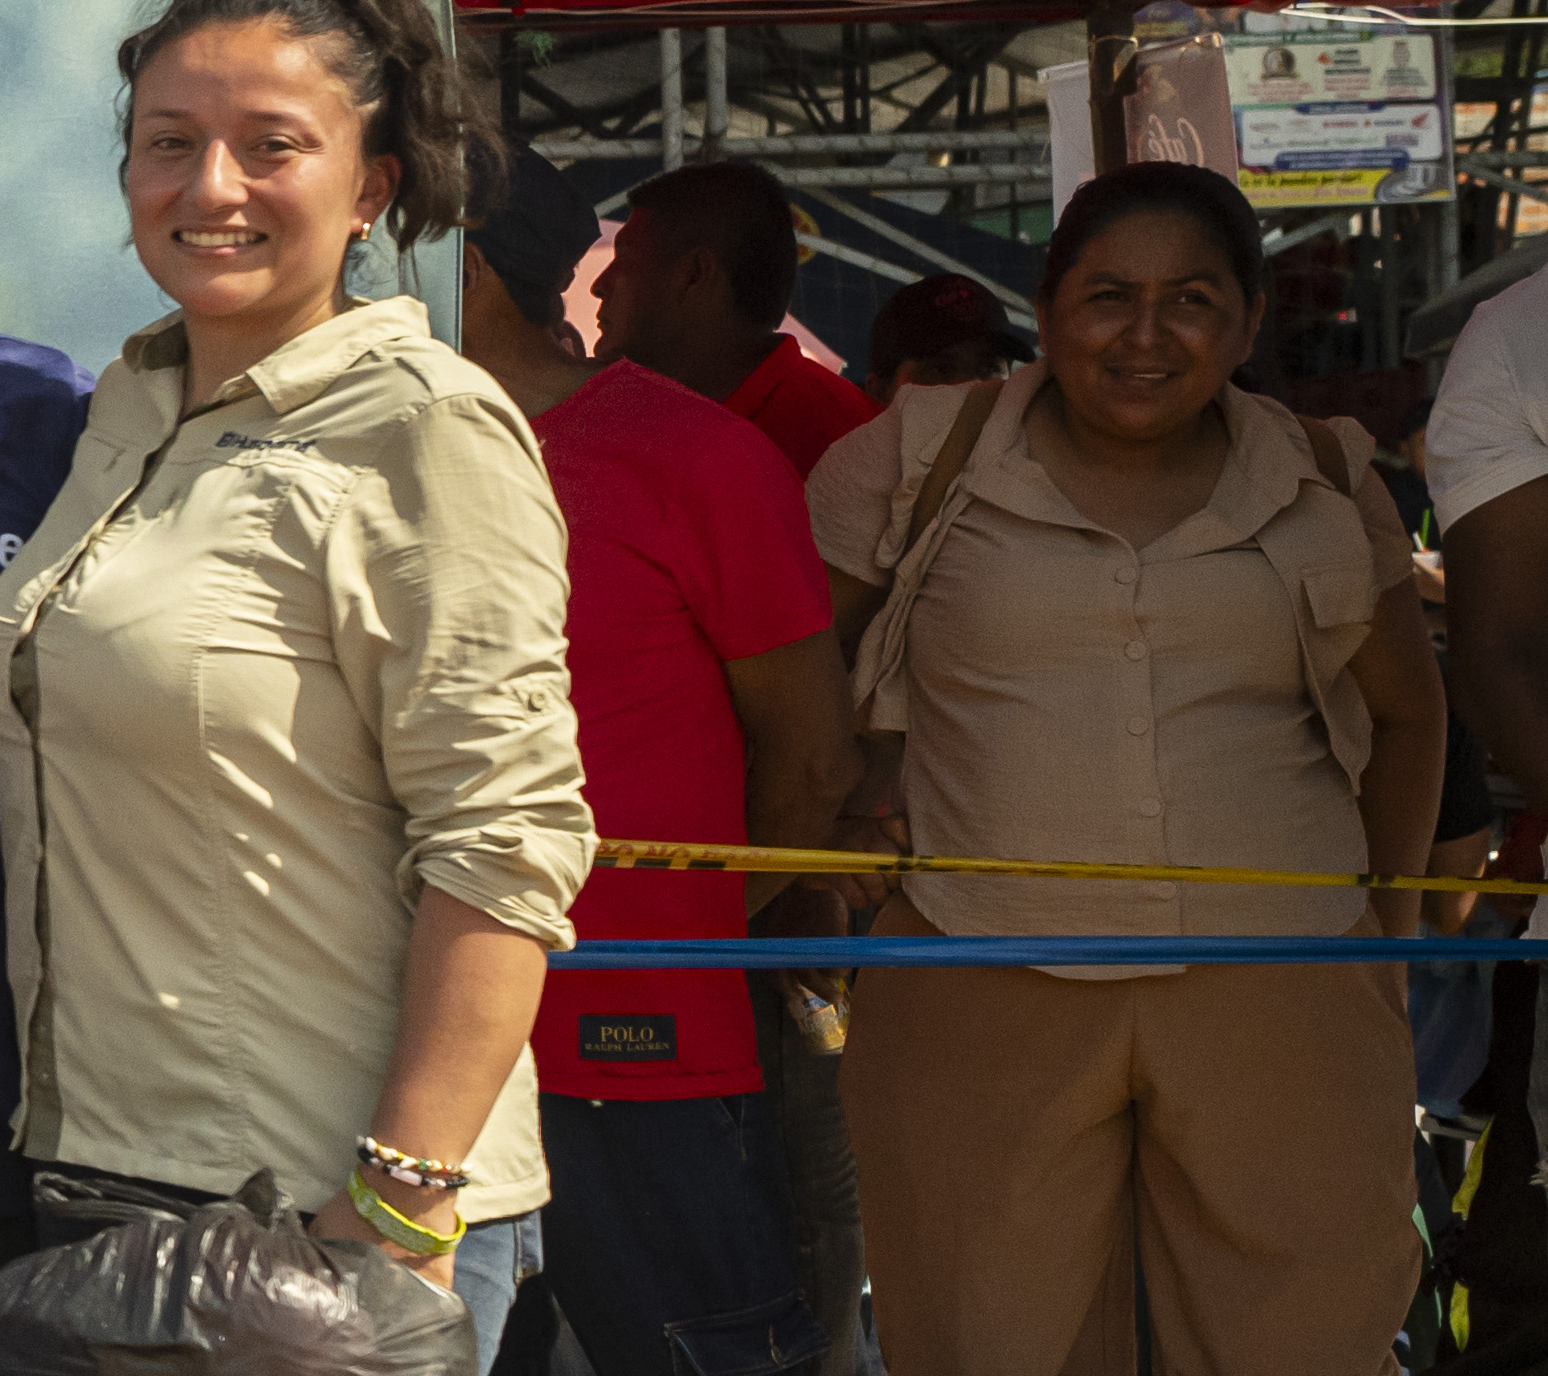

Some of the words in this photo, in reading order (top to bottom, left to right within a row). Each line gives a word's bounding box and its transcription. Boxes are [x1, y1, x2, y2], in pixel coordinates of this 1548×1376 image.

[600, 1025, 655, 1043] POLO
[584, 1042, 623, 1053] RALPH
[627, 1041, 671, 1052] LAUREN
